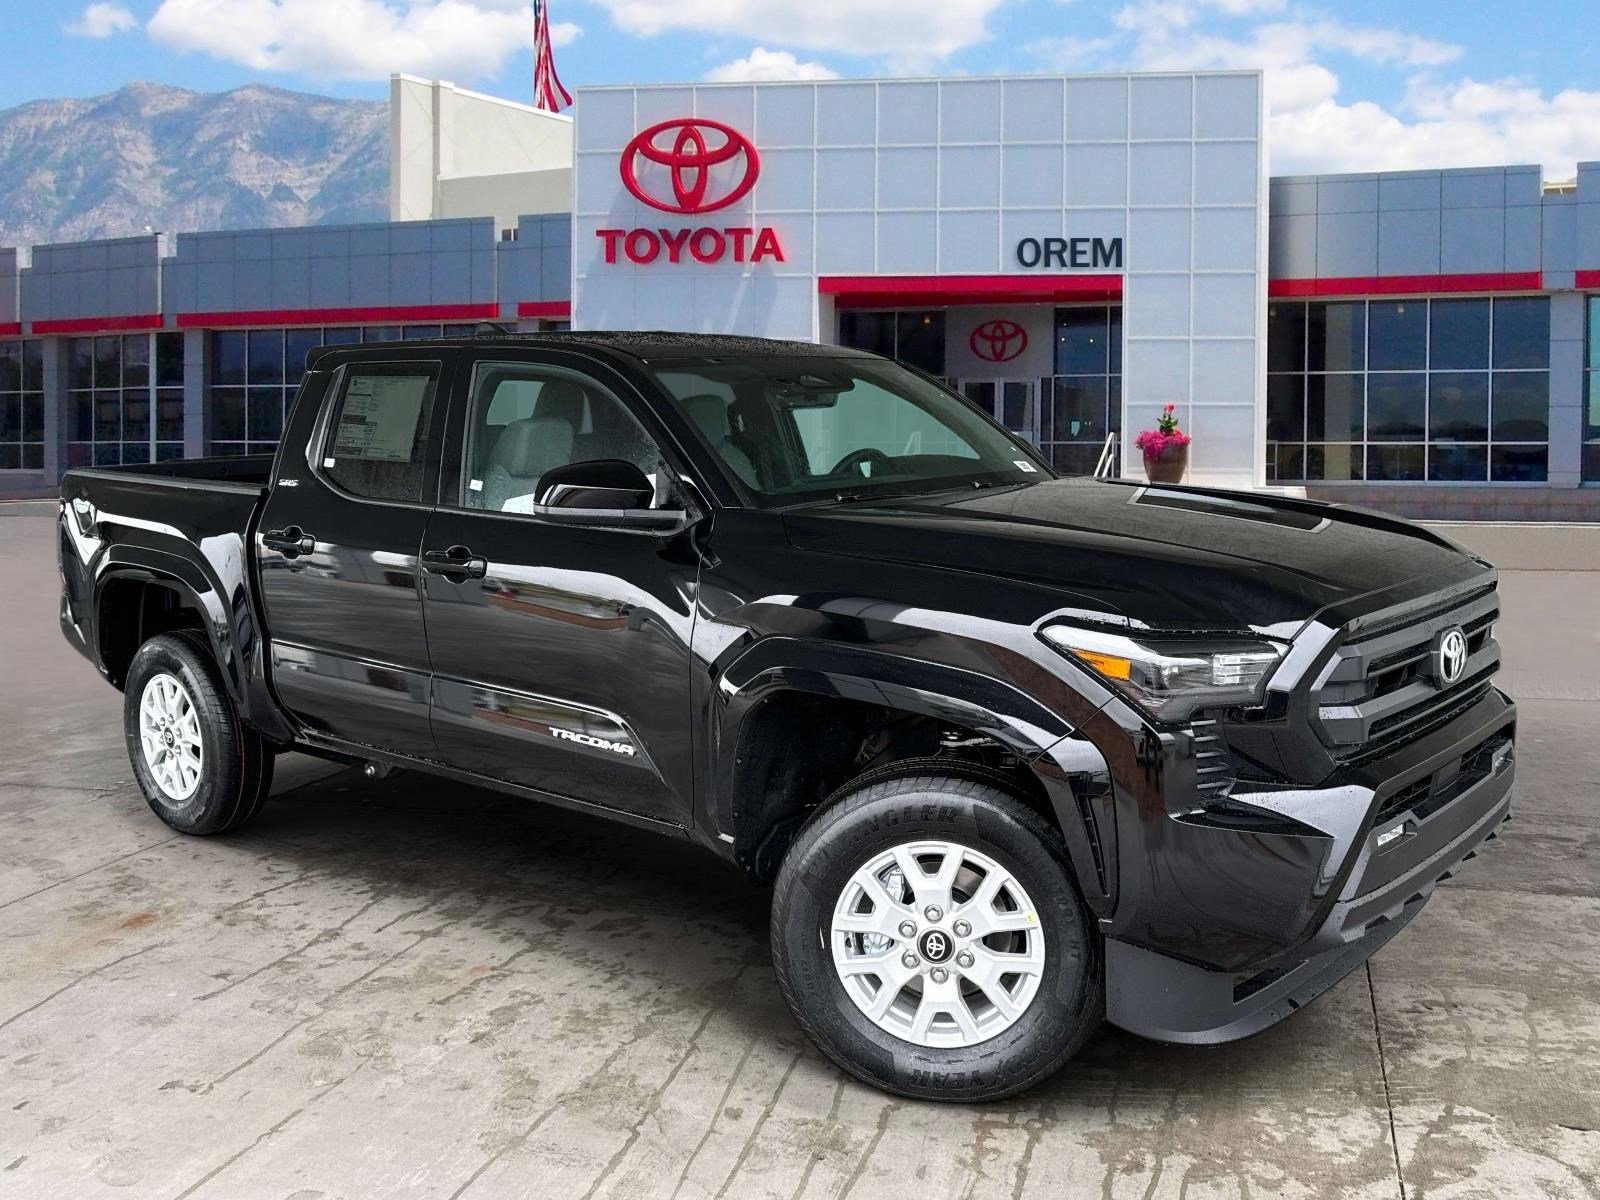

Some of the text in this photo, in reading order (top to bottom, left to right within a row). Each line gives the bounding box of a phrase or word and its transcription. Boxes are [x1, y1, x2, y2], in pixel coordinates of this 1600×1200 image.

[596, 227, 785, 264] TOYOTA
[1016, 237, 1123, 268] OREM
[548, 726, 636, 756] TACOMA
